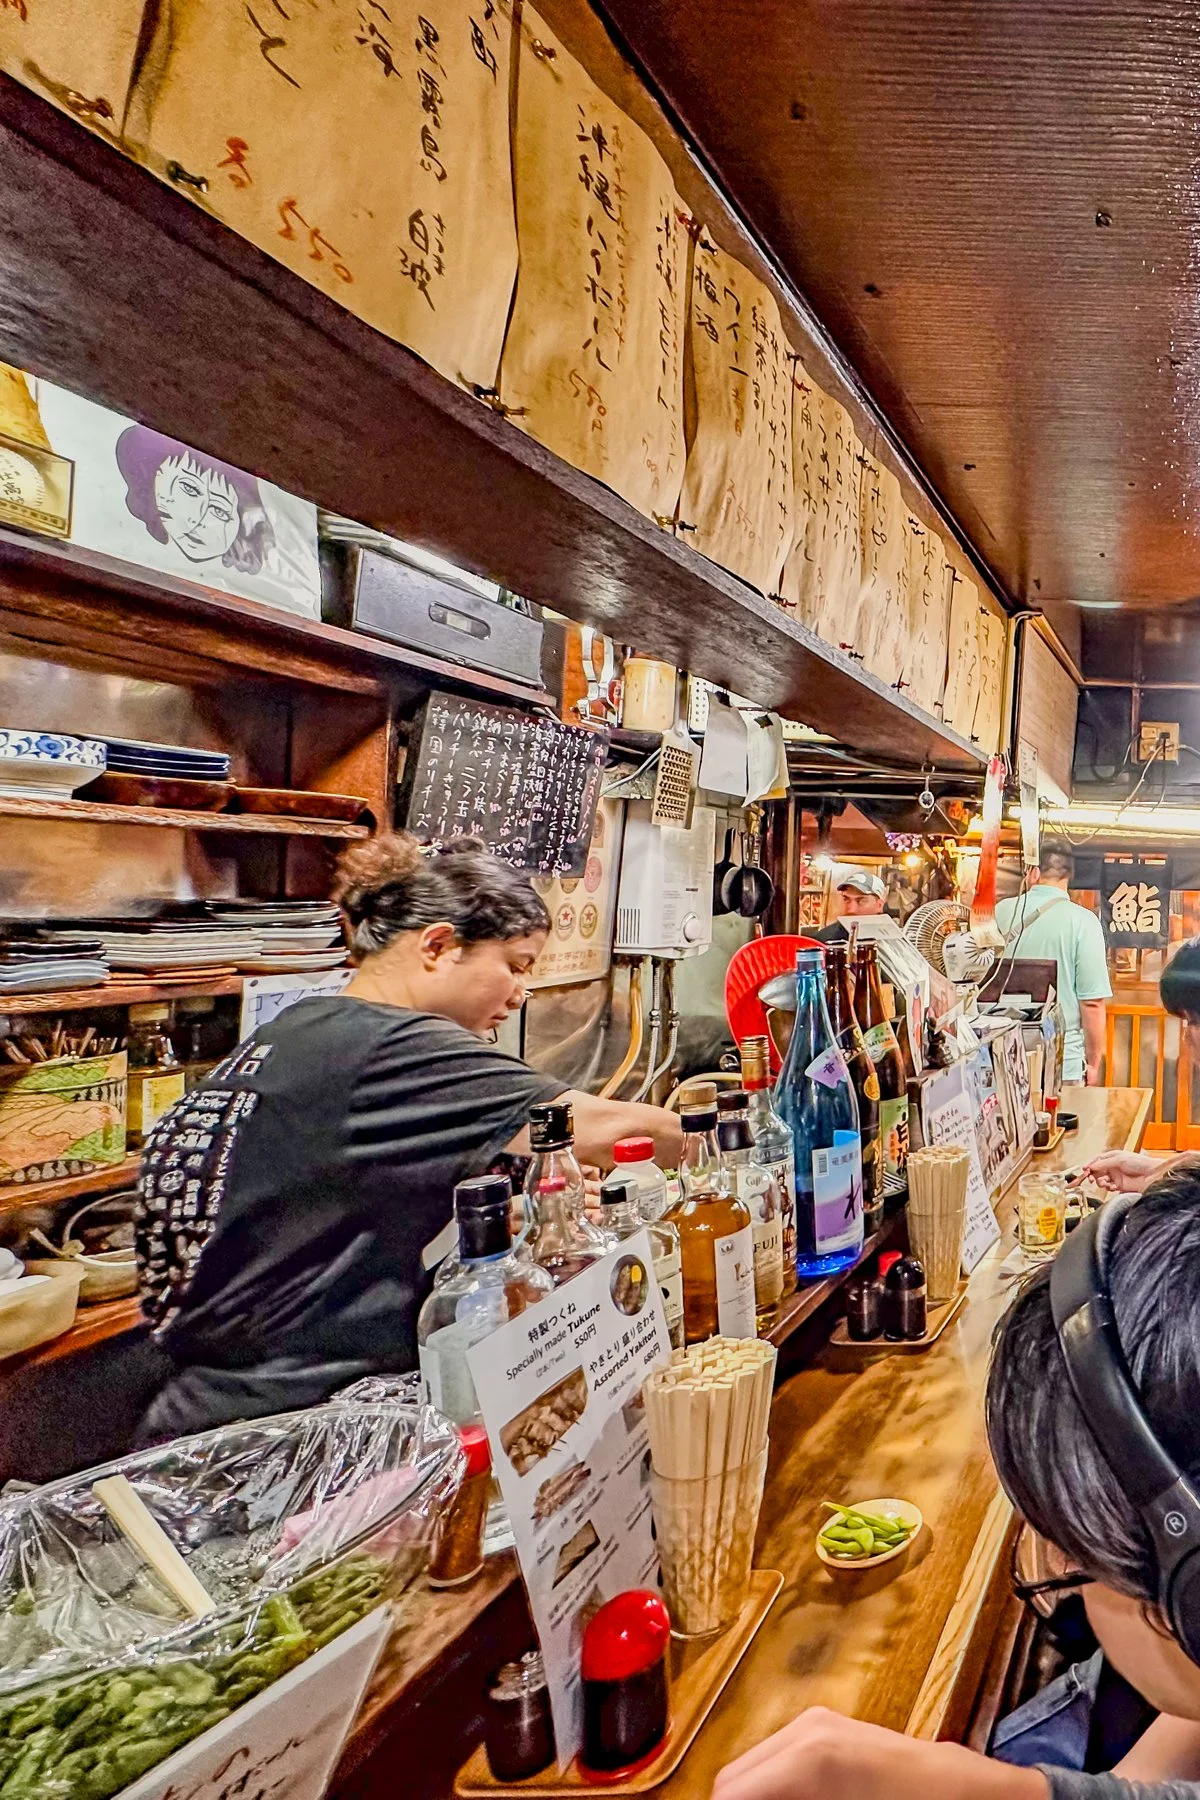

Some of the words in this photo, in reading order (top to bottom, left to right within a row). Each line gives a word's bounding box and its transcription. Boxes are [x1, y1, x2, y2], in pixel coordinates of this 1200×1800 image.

[695, 264, 722, 344] 梅酒
[1108, 882, 1161, 933] 鮨
[754, 1236, 778, 1254] FUJI
[506, 1347, 543, 1381] Specially
[544, 1328, 567, 1352] made
[567, 1303, 601, 1334] Tukune
[527, 1302, 576, 1344] 特製つくね
[574, 1322, 597, 1350] 550円
[589, 1342, 620, 1374] やきとり
[621, 1310, 655, 1348] 盛り合わせ
[593, 1350, 629, 1391] Assorted
[628, 1326, 657, 1357] Yakitori
[643, 1342, 661, 1366] 680円
